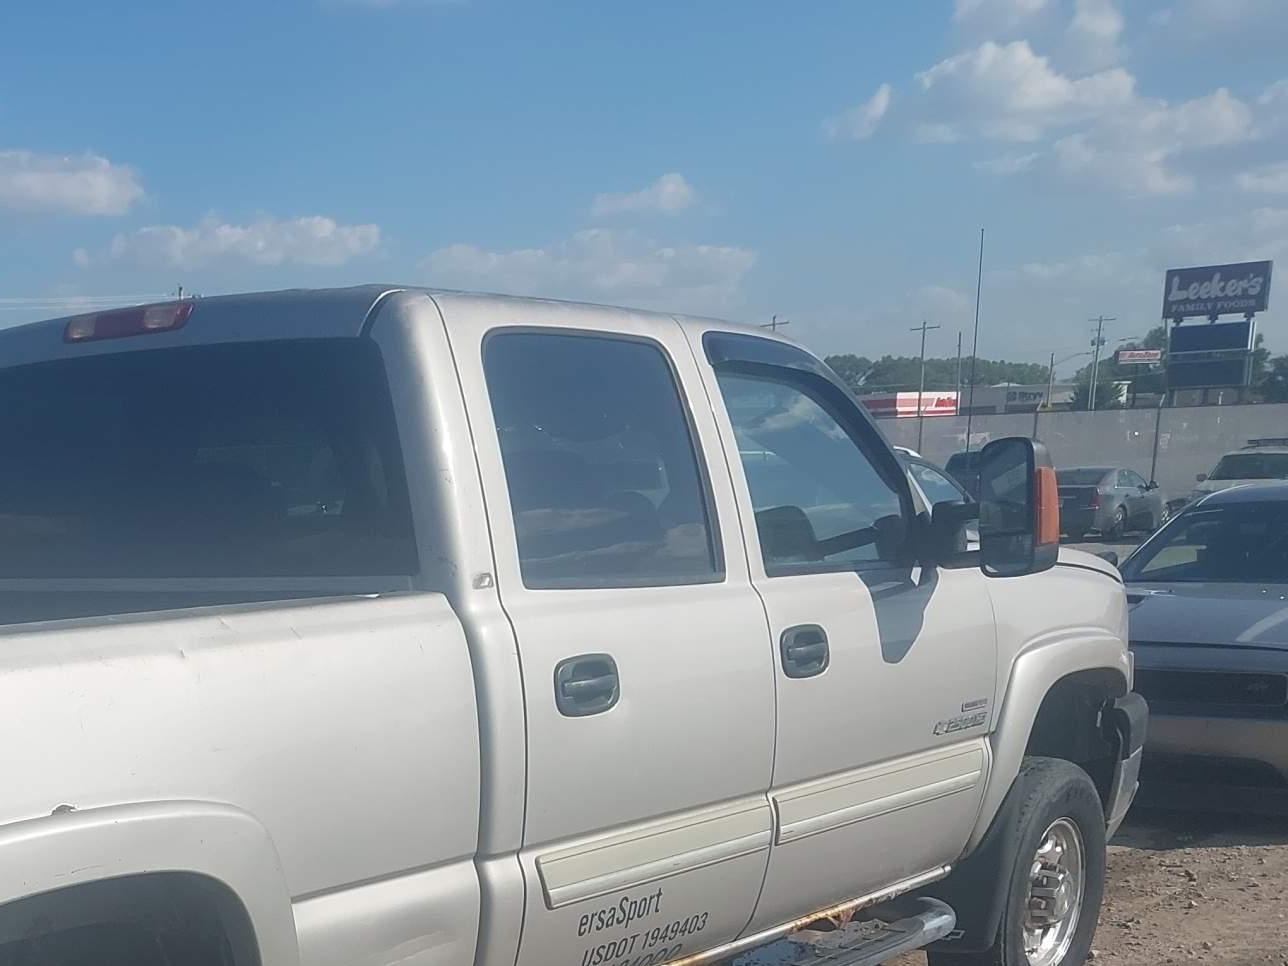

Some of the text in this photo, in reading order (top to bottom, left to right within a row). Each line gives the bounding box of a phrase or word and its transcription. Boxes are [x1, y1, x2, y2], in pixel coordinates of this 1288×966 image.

[1168, 272, 1264, 301] Leeker's
[1172, 299, 1256, 313] FAMILY FOODS
[578, 888, 663, 937] ersaSport
[641, 911, 709, 950] 1949403
